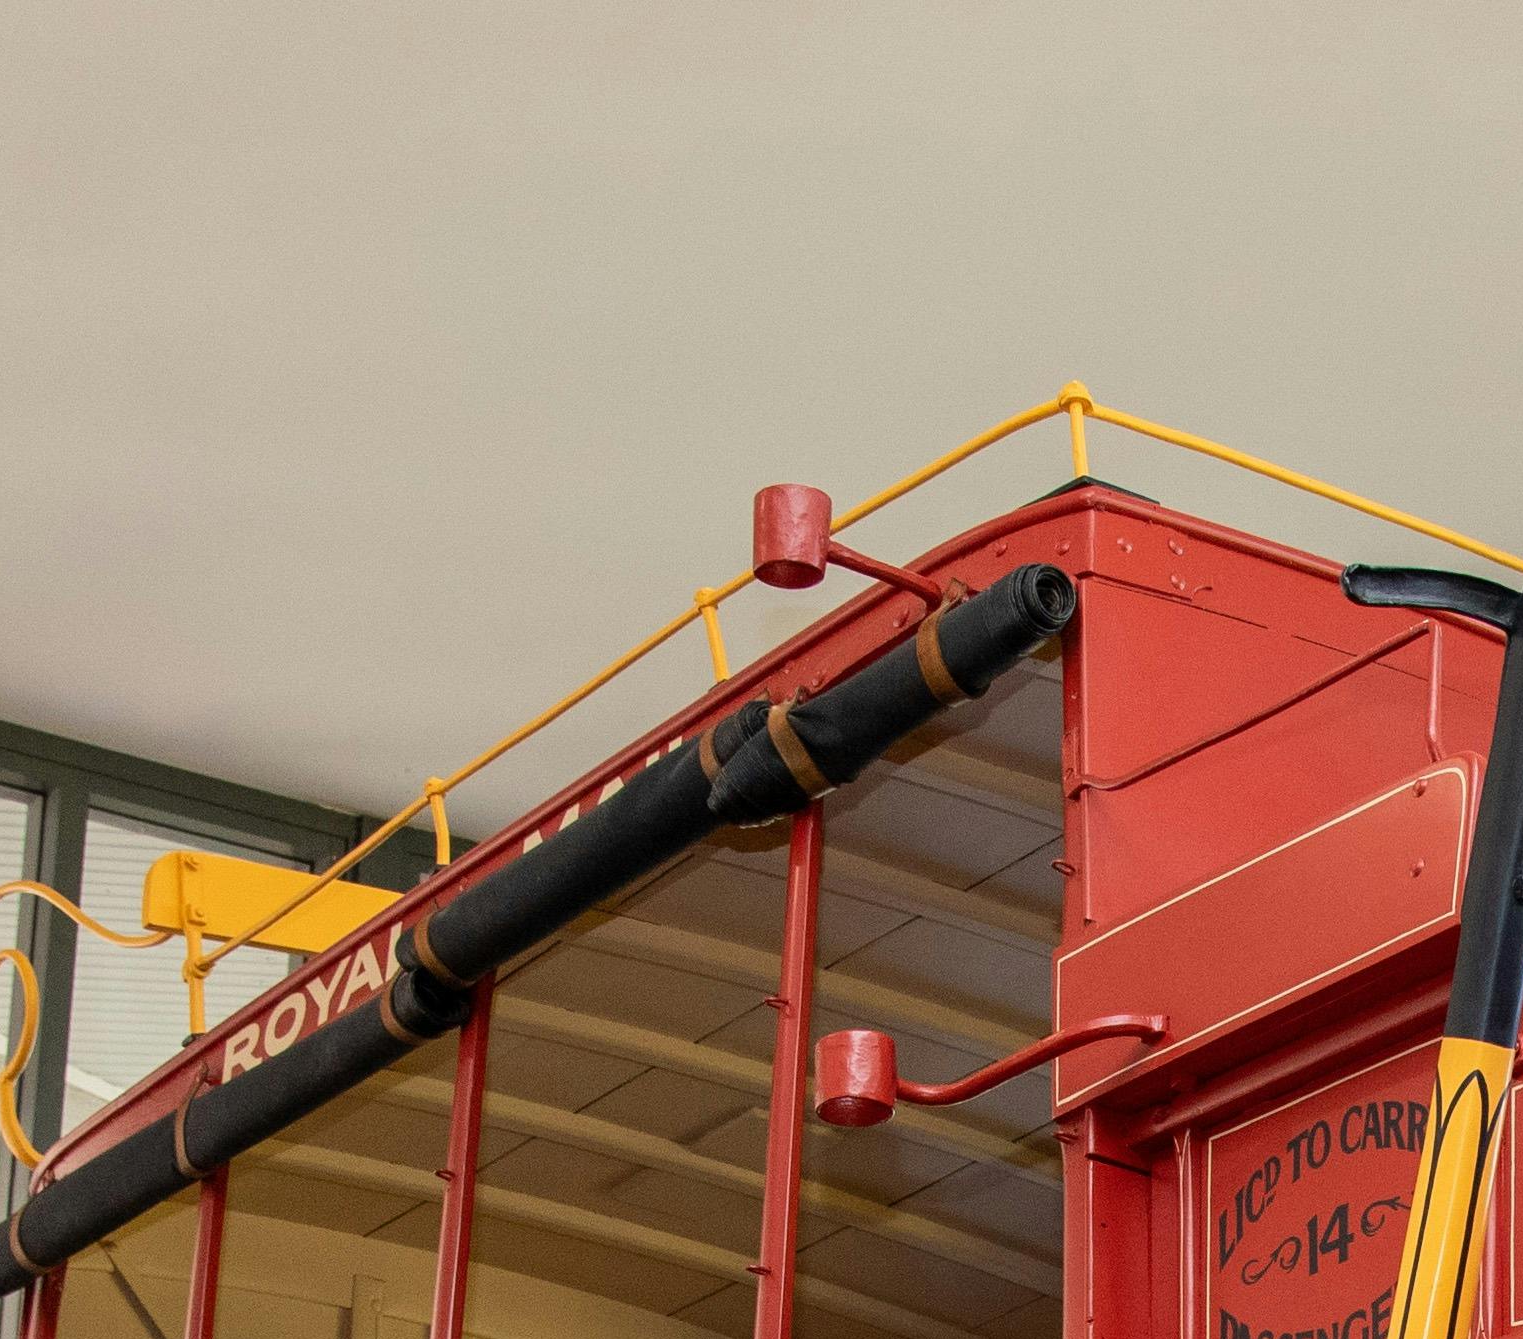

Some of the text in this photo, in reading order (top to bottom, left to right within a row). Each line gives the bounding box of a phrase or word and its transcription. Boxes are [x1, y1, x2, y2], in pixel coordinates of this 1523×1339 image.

[1286, 1119, 1331, 1184] TO
[1340, 1101, 1429, 1155] CARR
[1307, 1203, 1354, 1276] 14
